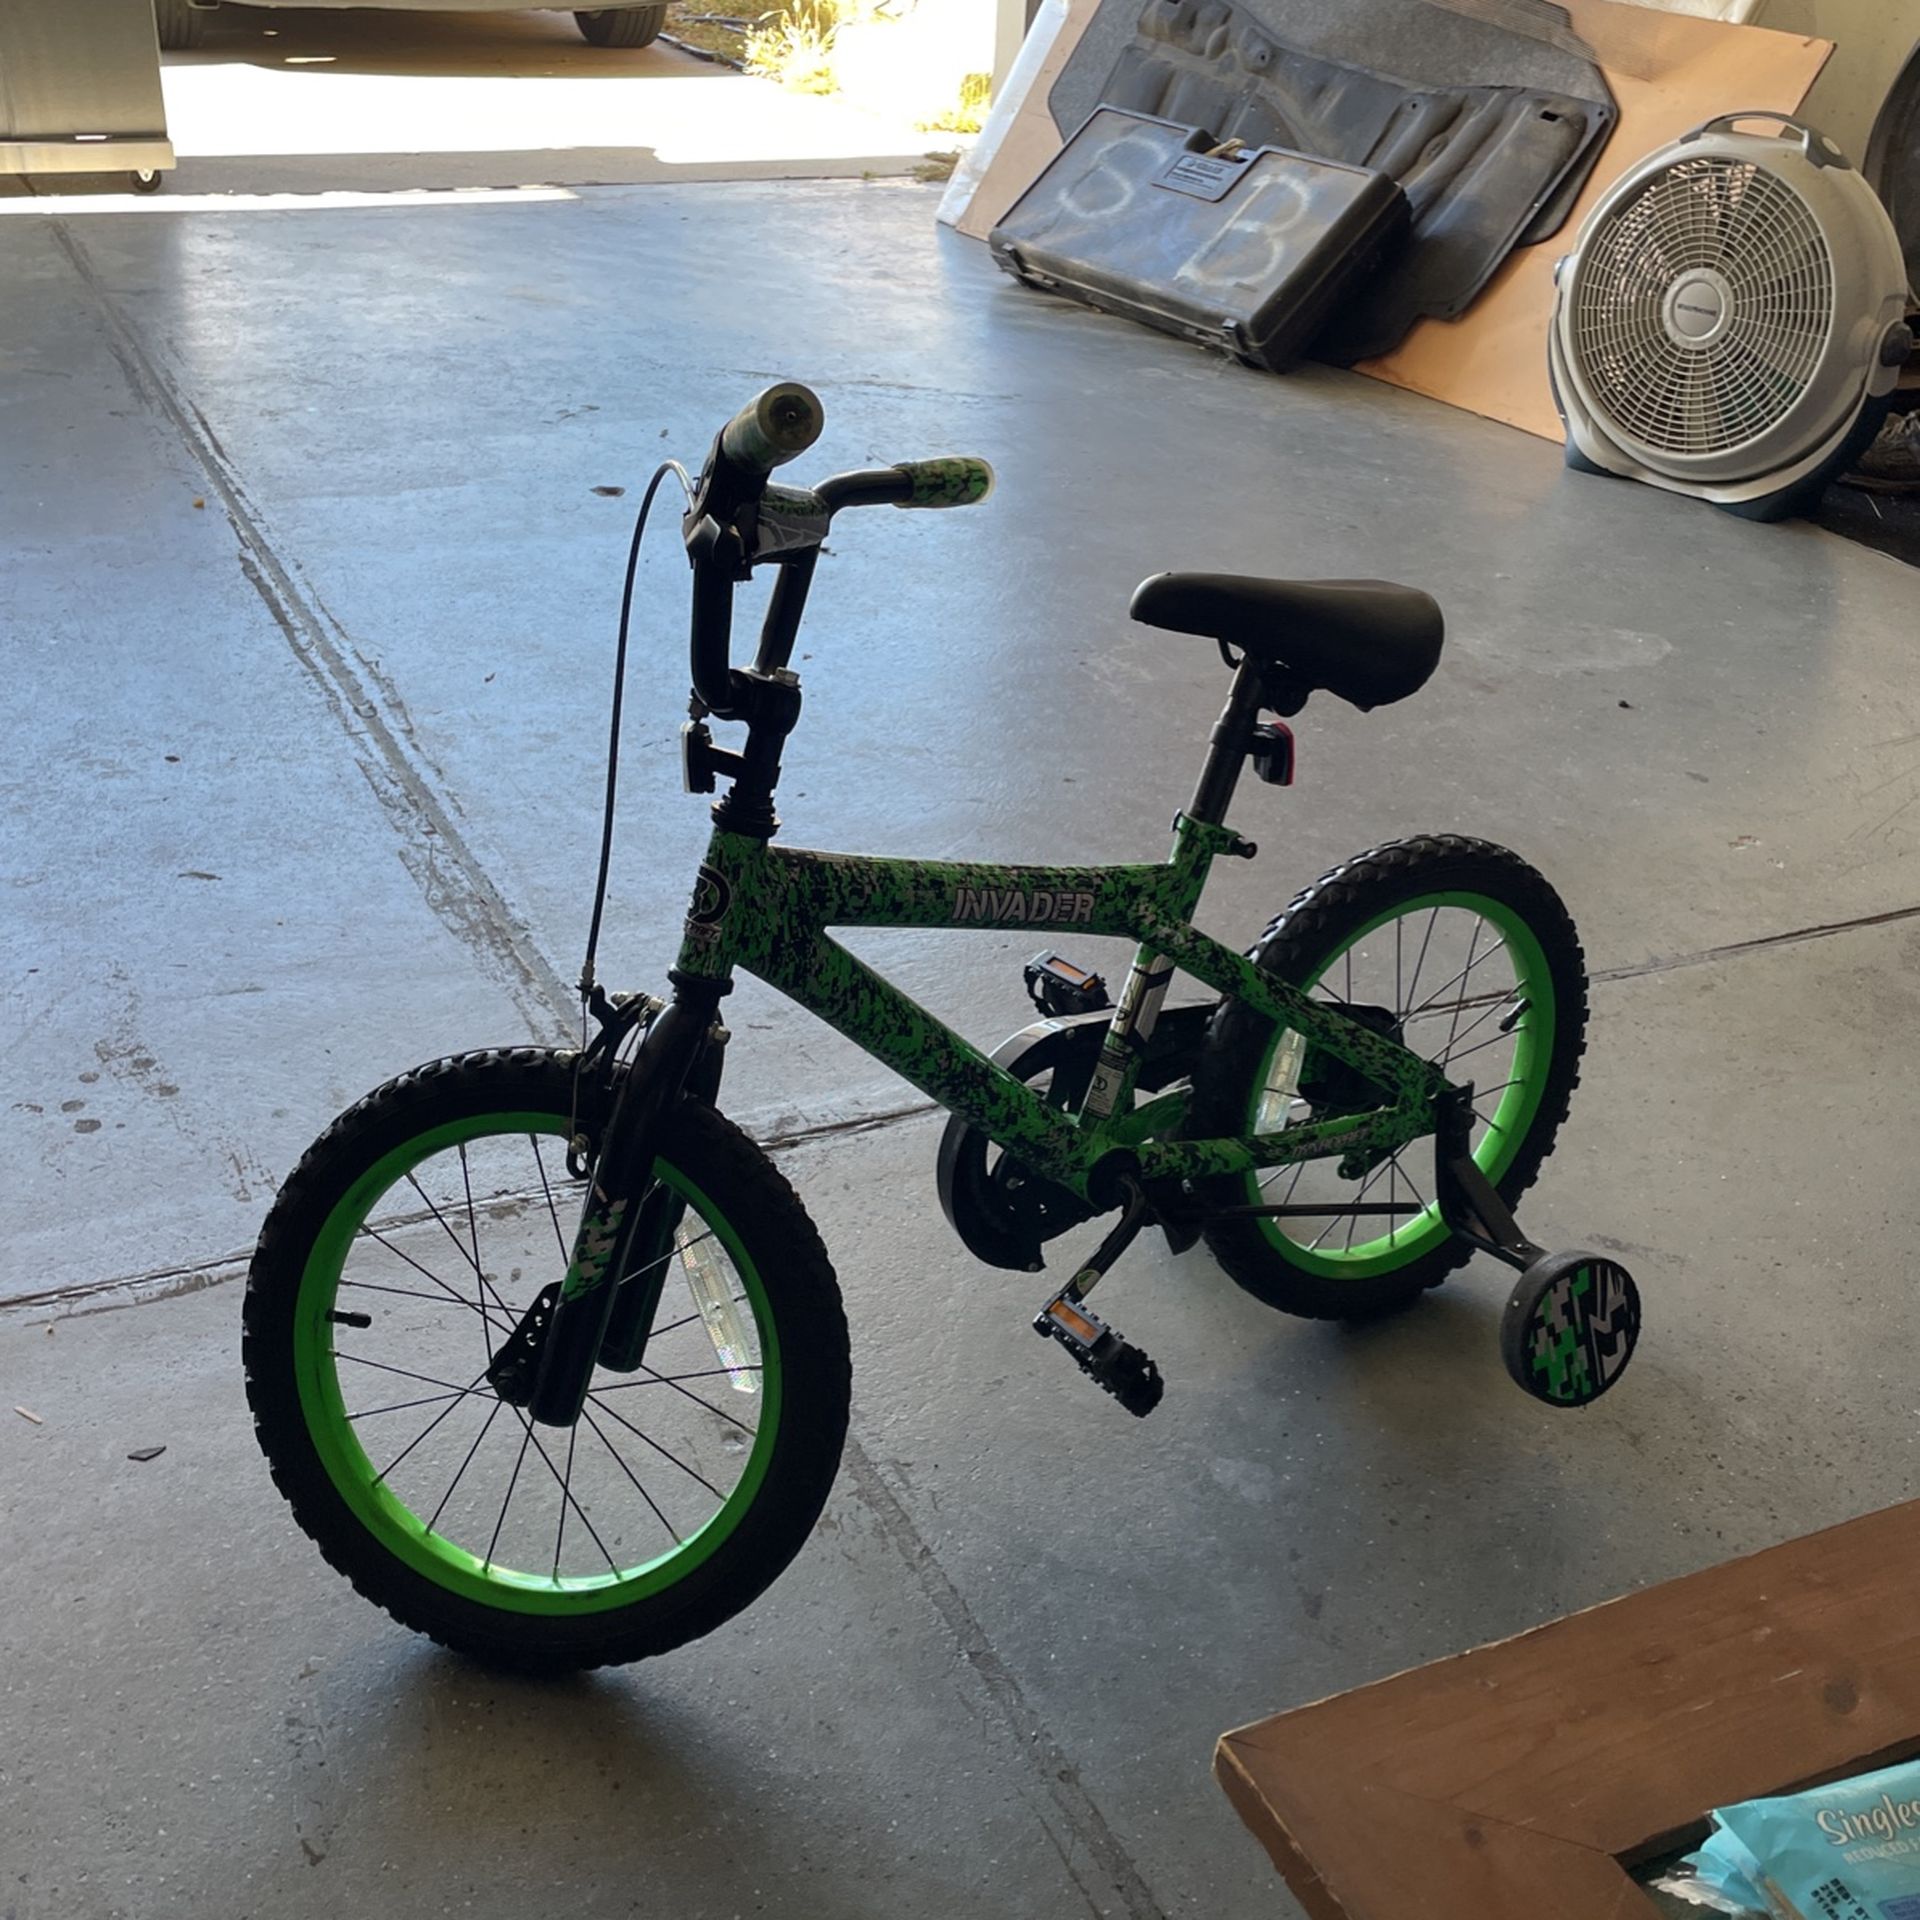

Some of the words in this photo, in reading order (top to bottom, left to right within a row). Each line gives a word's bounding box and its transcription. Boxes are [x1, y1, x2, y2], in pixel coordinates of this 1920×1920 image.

[1174, 172, 1312, 287] B
[952, 887, 1096, 923] INVADER
[1842, 1840, 1909, 1866] REDUCED
[1830, 1877, 1857, 1905] BEST
